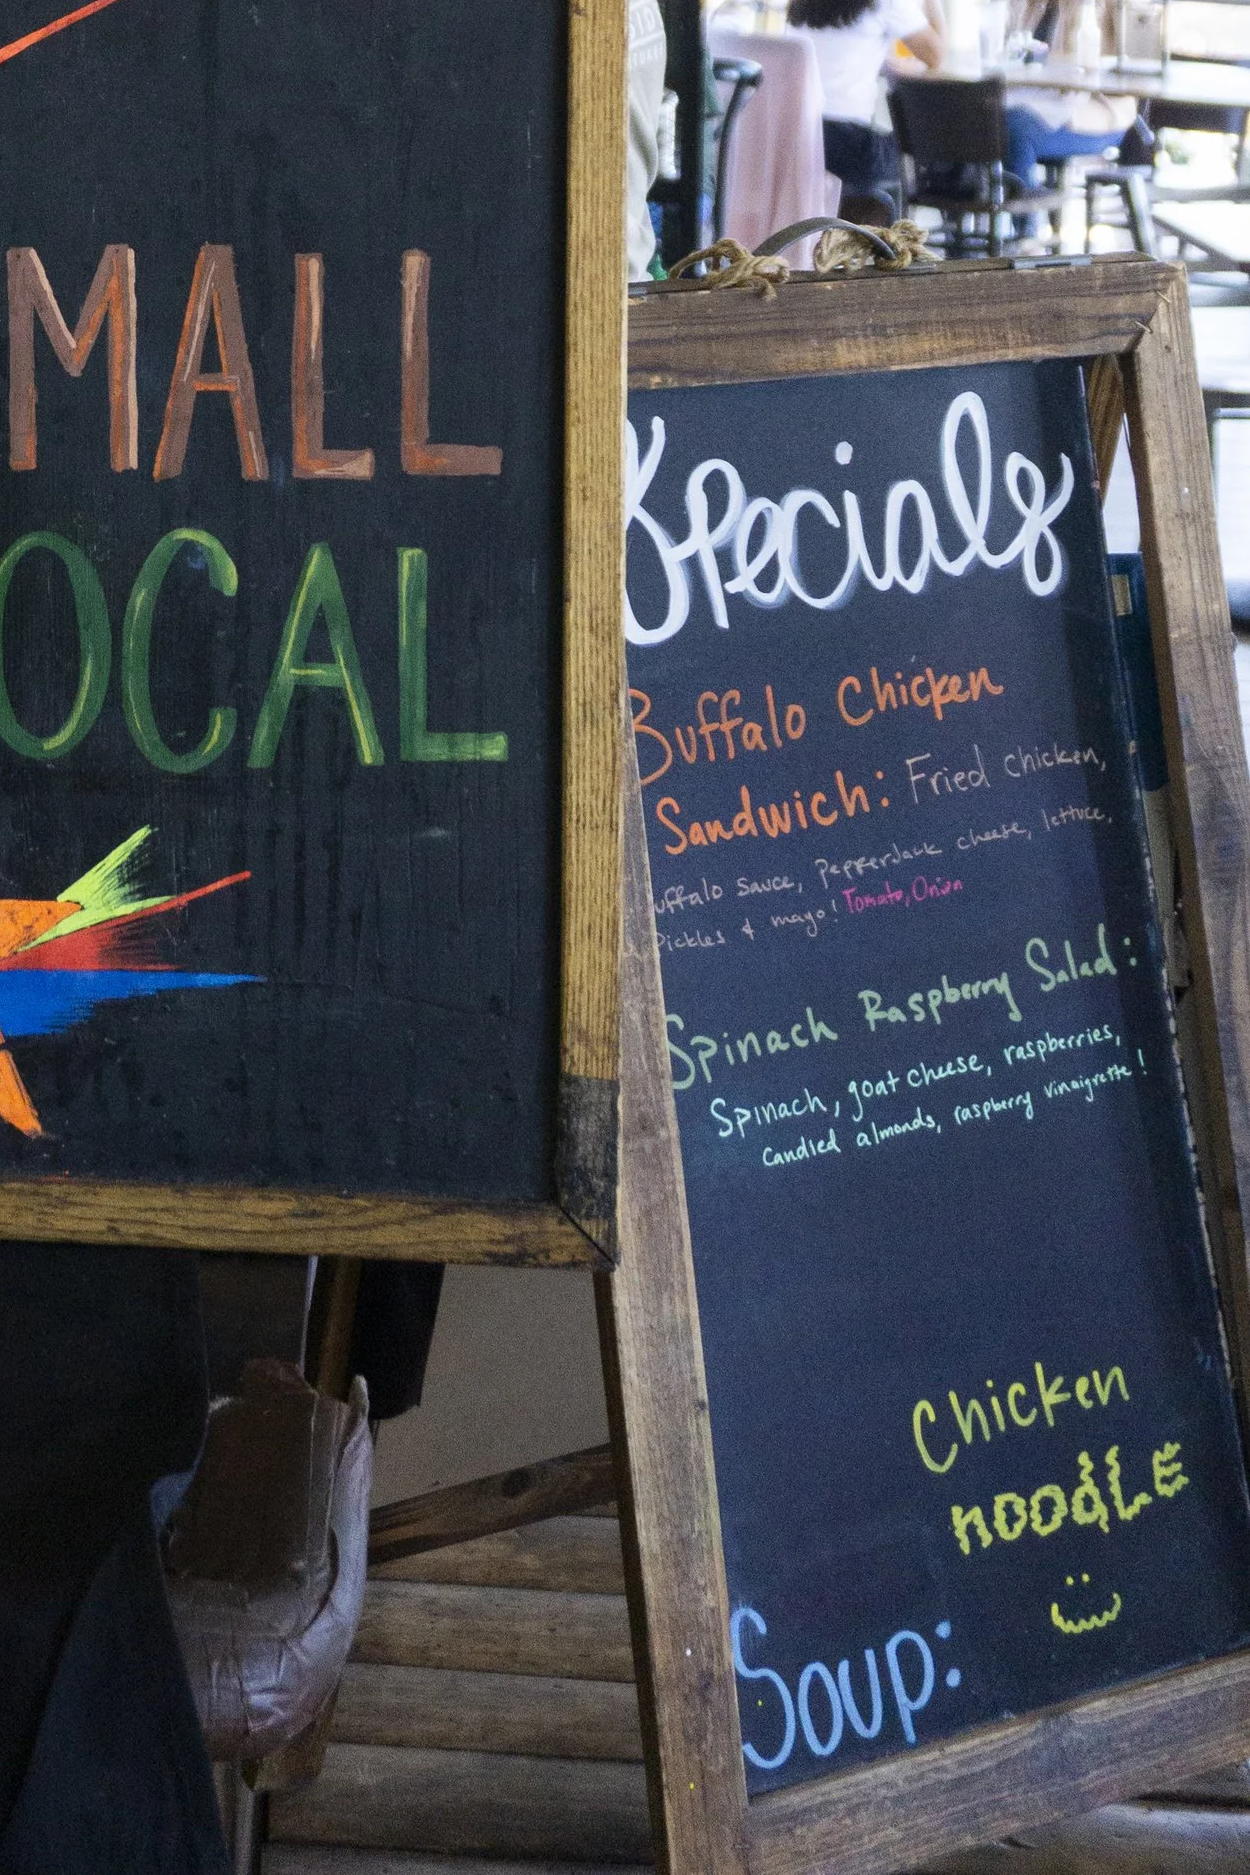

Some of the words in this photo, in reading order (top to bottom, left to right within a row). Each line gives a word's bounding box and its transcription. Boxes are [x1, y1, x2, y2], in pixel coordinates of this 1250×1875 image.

[625, 390, 1075, 647] Specials
[628, 685, 808, 787] Buffalo
[836, 666, 1005, 727] Chicken
[656, 768, 890, 857] Sandwich:
[904, 743, 992, 805] Fried
[654, 877, 724, 915] uffalo
[663, 1006, 840, 1090] Spinach
[857, 971, 1023, 1032] Raspberry
[847, 1074, 901, 1123] goat
[1002, 1024, 1123, 1068] raspberries,
[855, 1106, 943, 1149] almonds,
[953, 1087, 1035, 1128] raspberry
[911, 1361, 1131, 1474] Chicken
